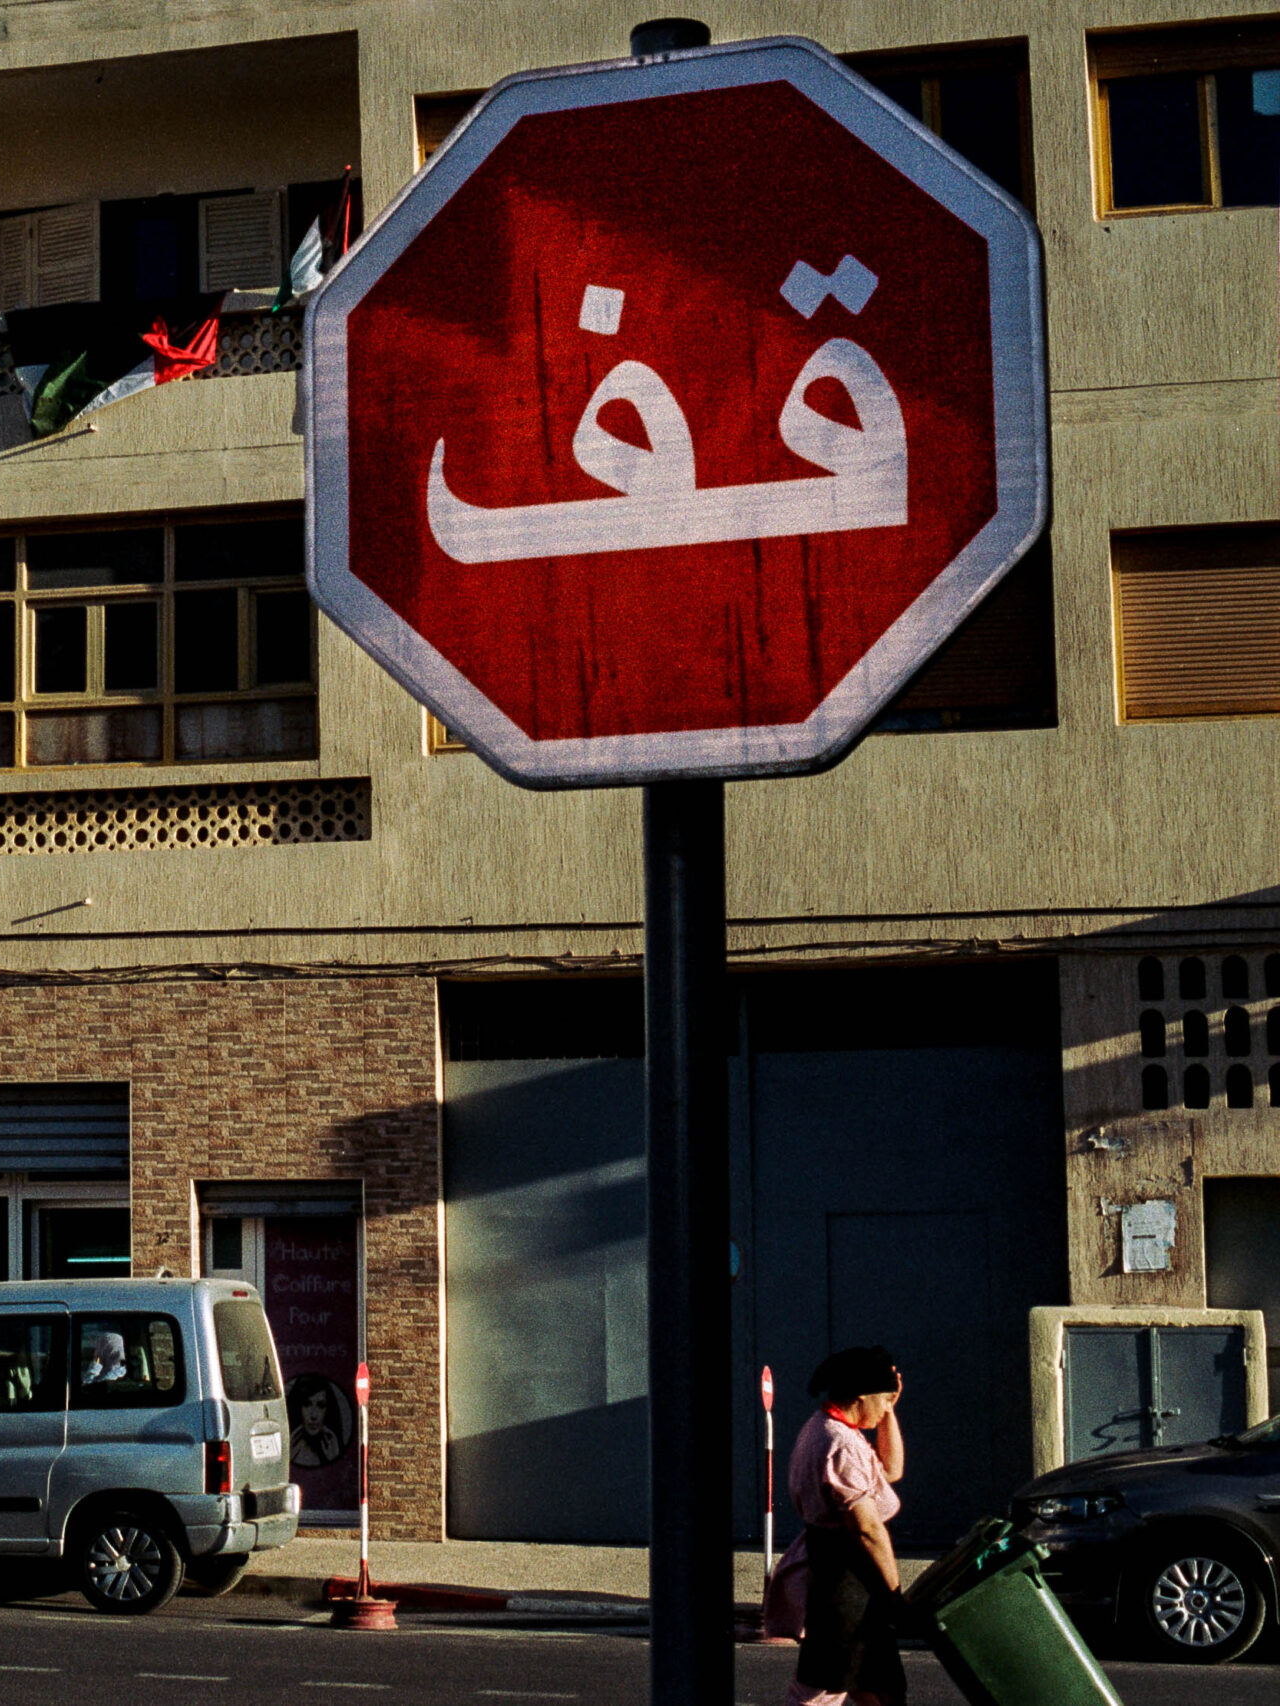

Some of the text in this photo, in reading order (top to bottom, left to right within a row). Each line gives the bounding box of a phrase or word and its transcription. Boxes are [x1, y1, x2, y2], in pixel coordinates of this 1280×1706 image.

[427, 254, 907, 564] قف
[272, 1273, 352, 1294] Coiffure
[288, 1306, 333, 1326] Pour
[276, 1340, 348, 1358] emmes
